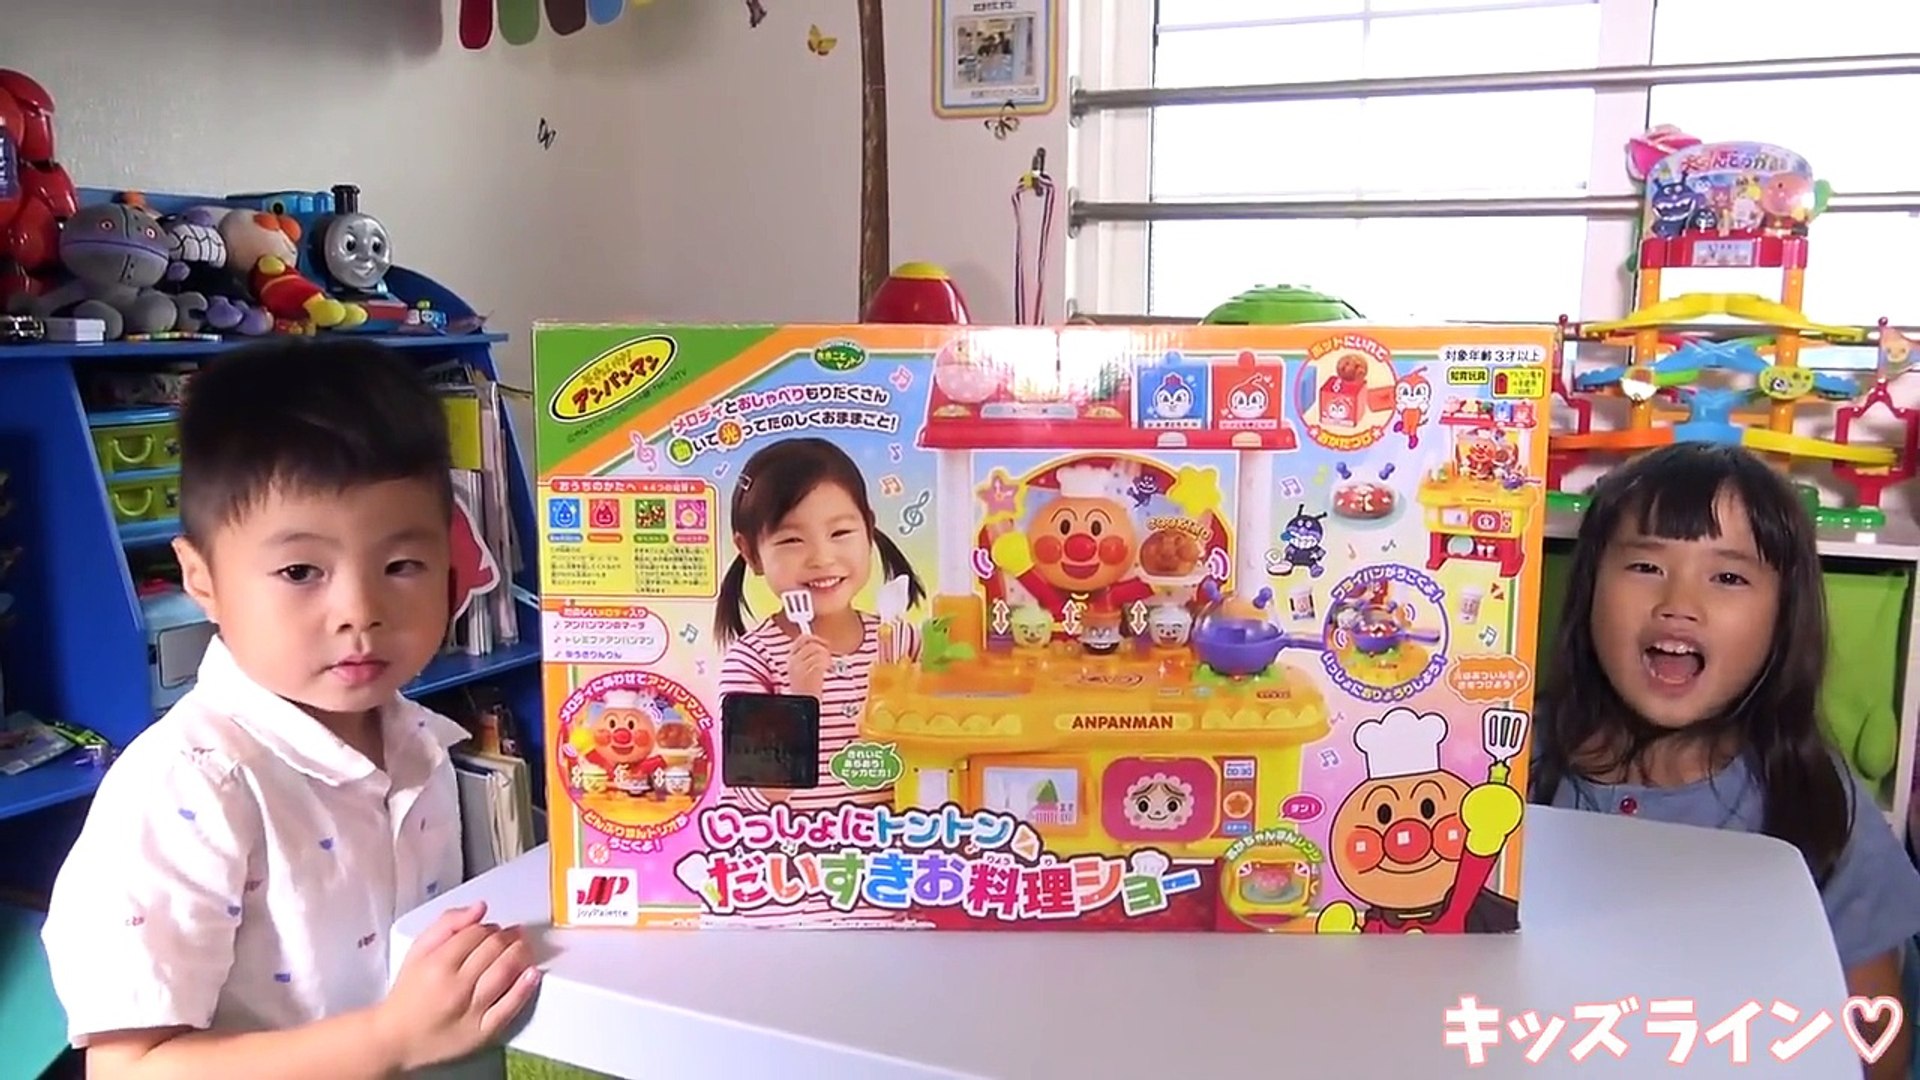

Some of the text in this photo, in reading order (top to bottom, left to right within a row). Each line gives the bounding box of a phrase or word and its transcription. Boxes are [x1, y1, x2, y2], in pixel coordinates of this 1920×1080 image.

[1445, 350, 1540, 362] 対象年齢3才以上
[571, 355, 659, 413] アンパンマン
[674, 385, 888, 433] メロディとおしゃべりもりだくさん
[1072, 716, 1173, 730] ANPANMAN
[707, 805, 1010, 847] いっしょにトントン
[706, 852, 1200, 918] だいすきお料理ショー
